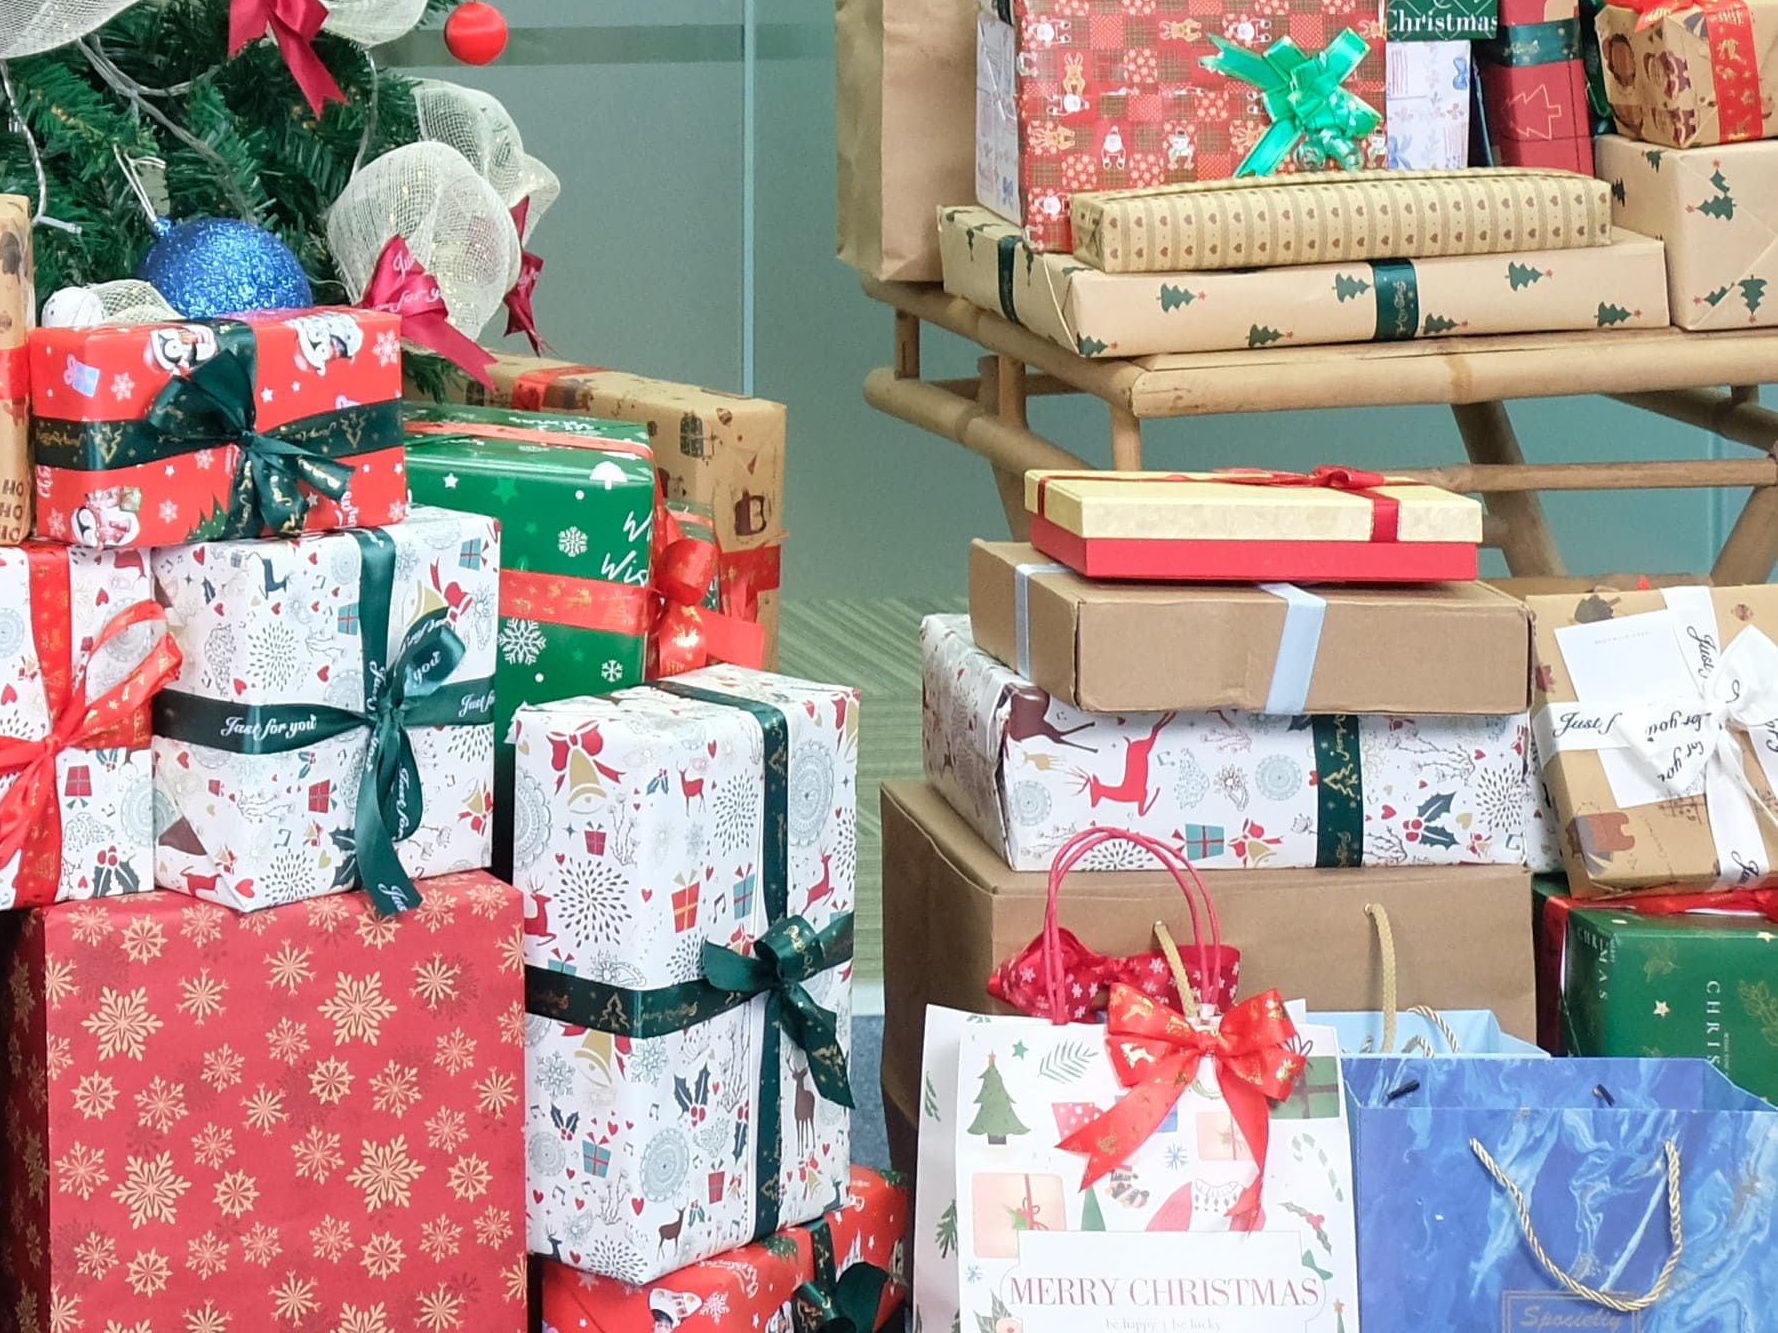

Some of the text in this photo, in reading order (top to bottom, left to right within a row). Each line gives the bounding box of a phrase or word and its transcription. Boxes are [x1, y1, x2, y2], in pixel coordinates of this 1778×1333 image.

[2, 479, 24, 497] HO
[413, 651, 441, 683] you
[459, 692, 487, 717] Just
[220, 714, 317, 742] Just for you
[1552, 712, 1611, 738] Just
[1010, 1277, 1320, 1307] MERRY CHRISTMAS
[1106, 1318, 1222, 1333] be happy be lucky
